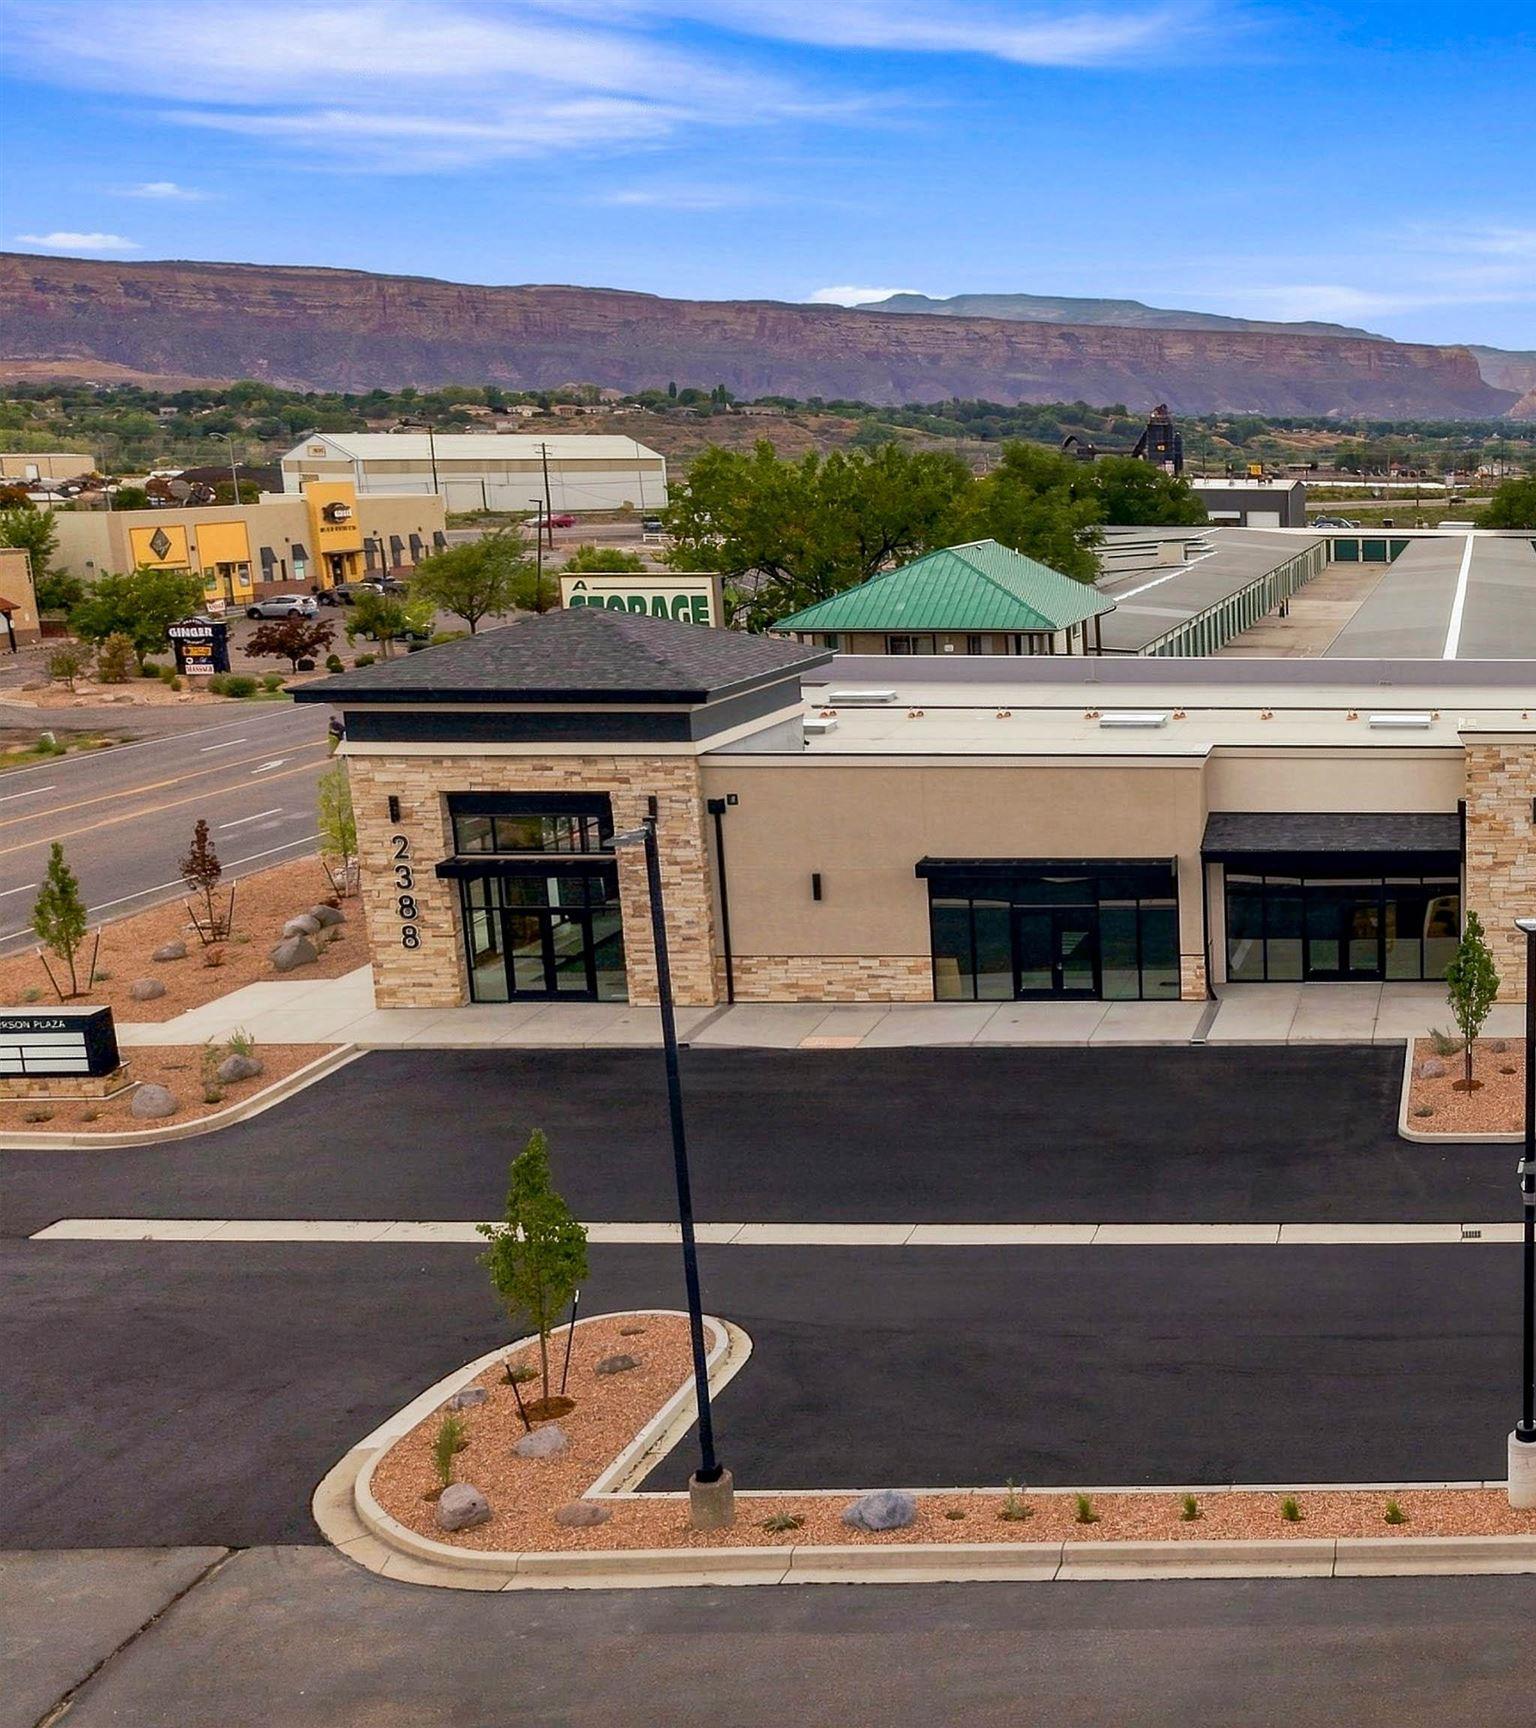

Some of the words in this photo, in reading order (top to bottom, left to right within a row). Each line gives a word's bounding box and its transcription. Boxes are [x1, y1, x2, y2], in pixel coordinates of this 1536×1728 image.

[572, 580, 588, 591] A
[569, 595, 710, 626] RAGE
[168, 627, 213, 638] GINGER
[392, 834, 420, 949] 2388
[33, 1020, 66, 1029] PLAZA
